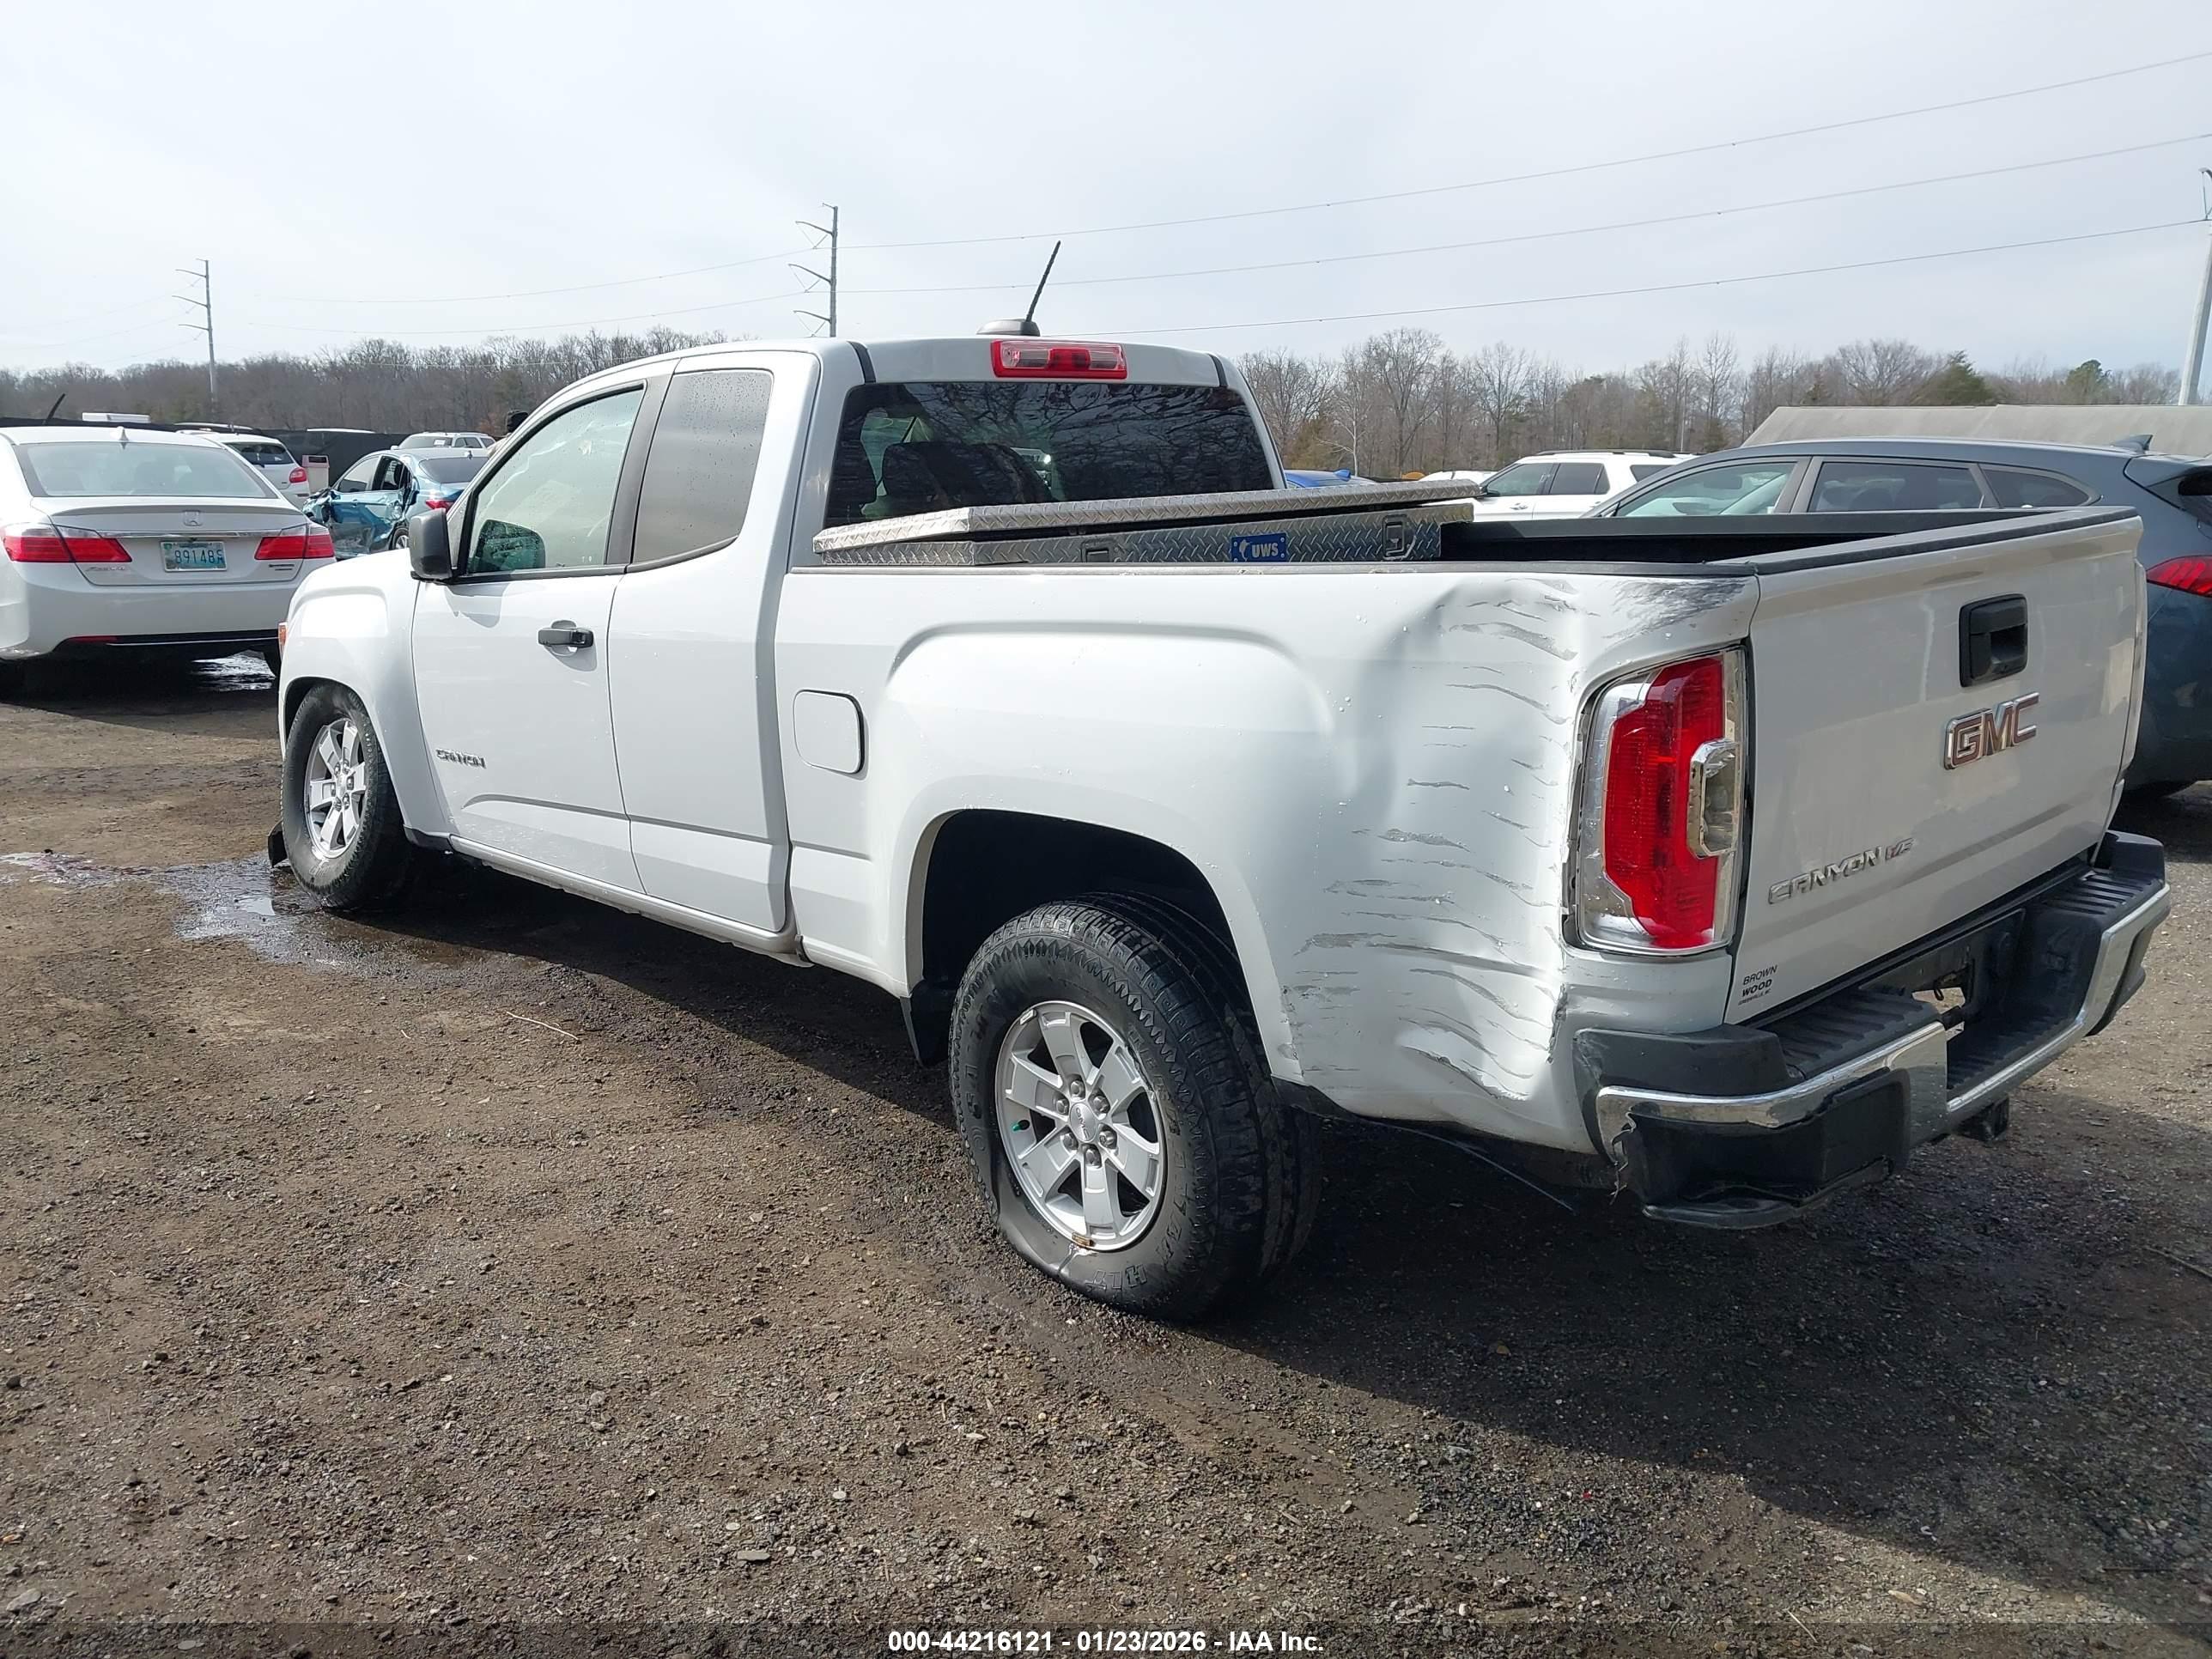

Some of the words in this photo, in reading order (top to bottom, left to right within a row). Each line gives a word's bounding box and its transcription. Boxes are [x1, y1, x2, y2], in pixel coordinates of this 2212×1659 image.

[1251, 542, 1279, 558] UWS
[1944, 691, 2039, 770] GMC
[1768, 846, 1883, 905] CANYON
[1741, 979, 1773, 997] WOOD
[1743, 964, 1778, 986] BROWN
[1075, 1107, 1091, 1140] GMC
